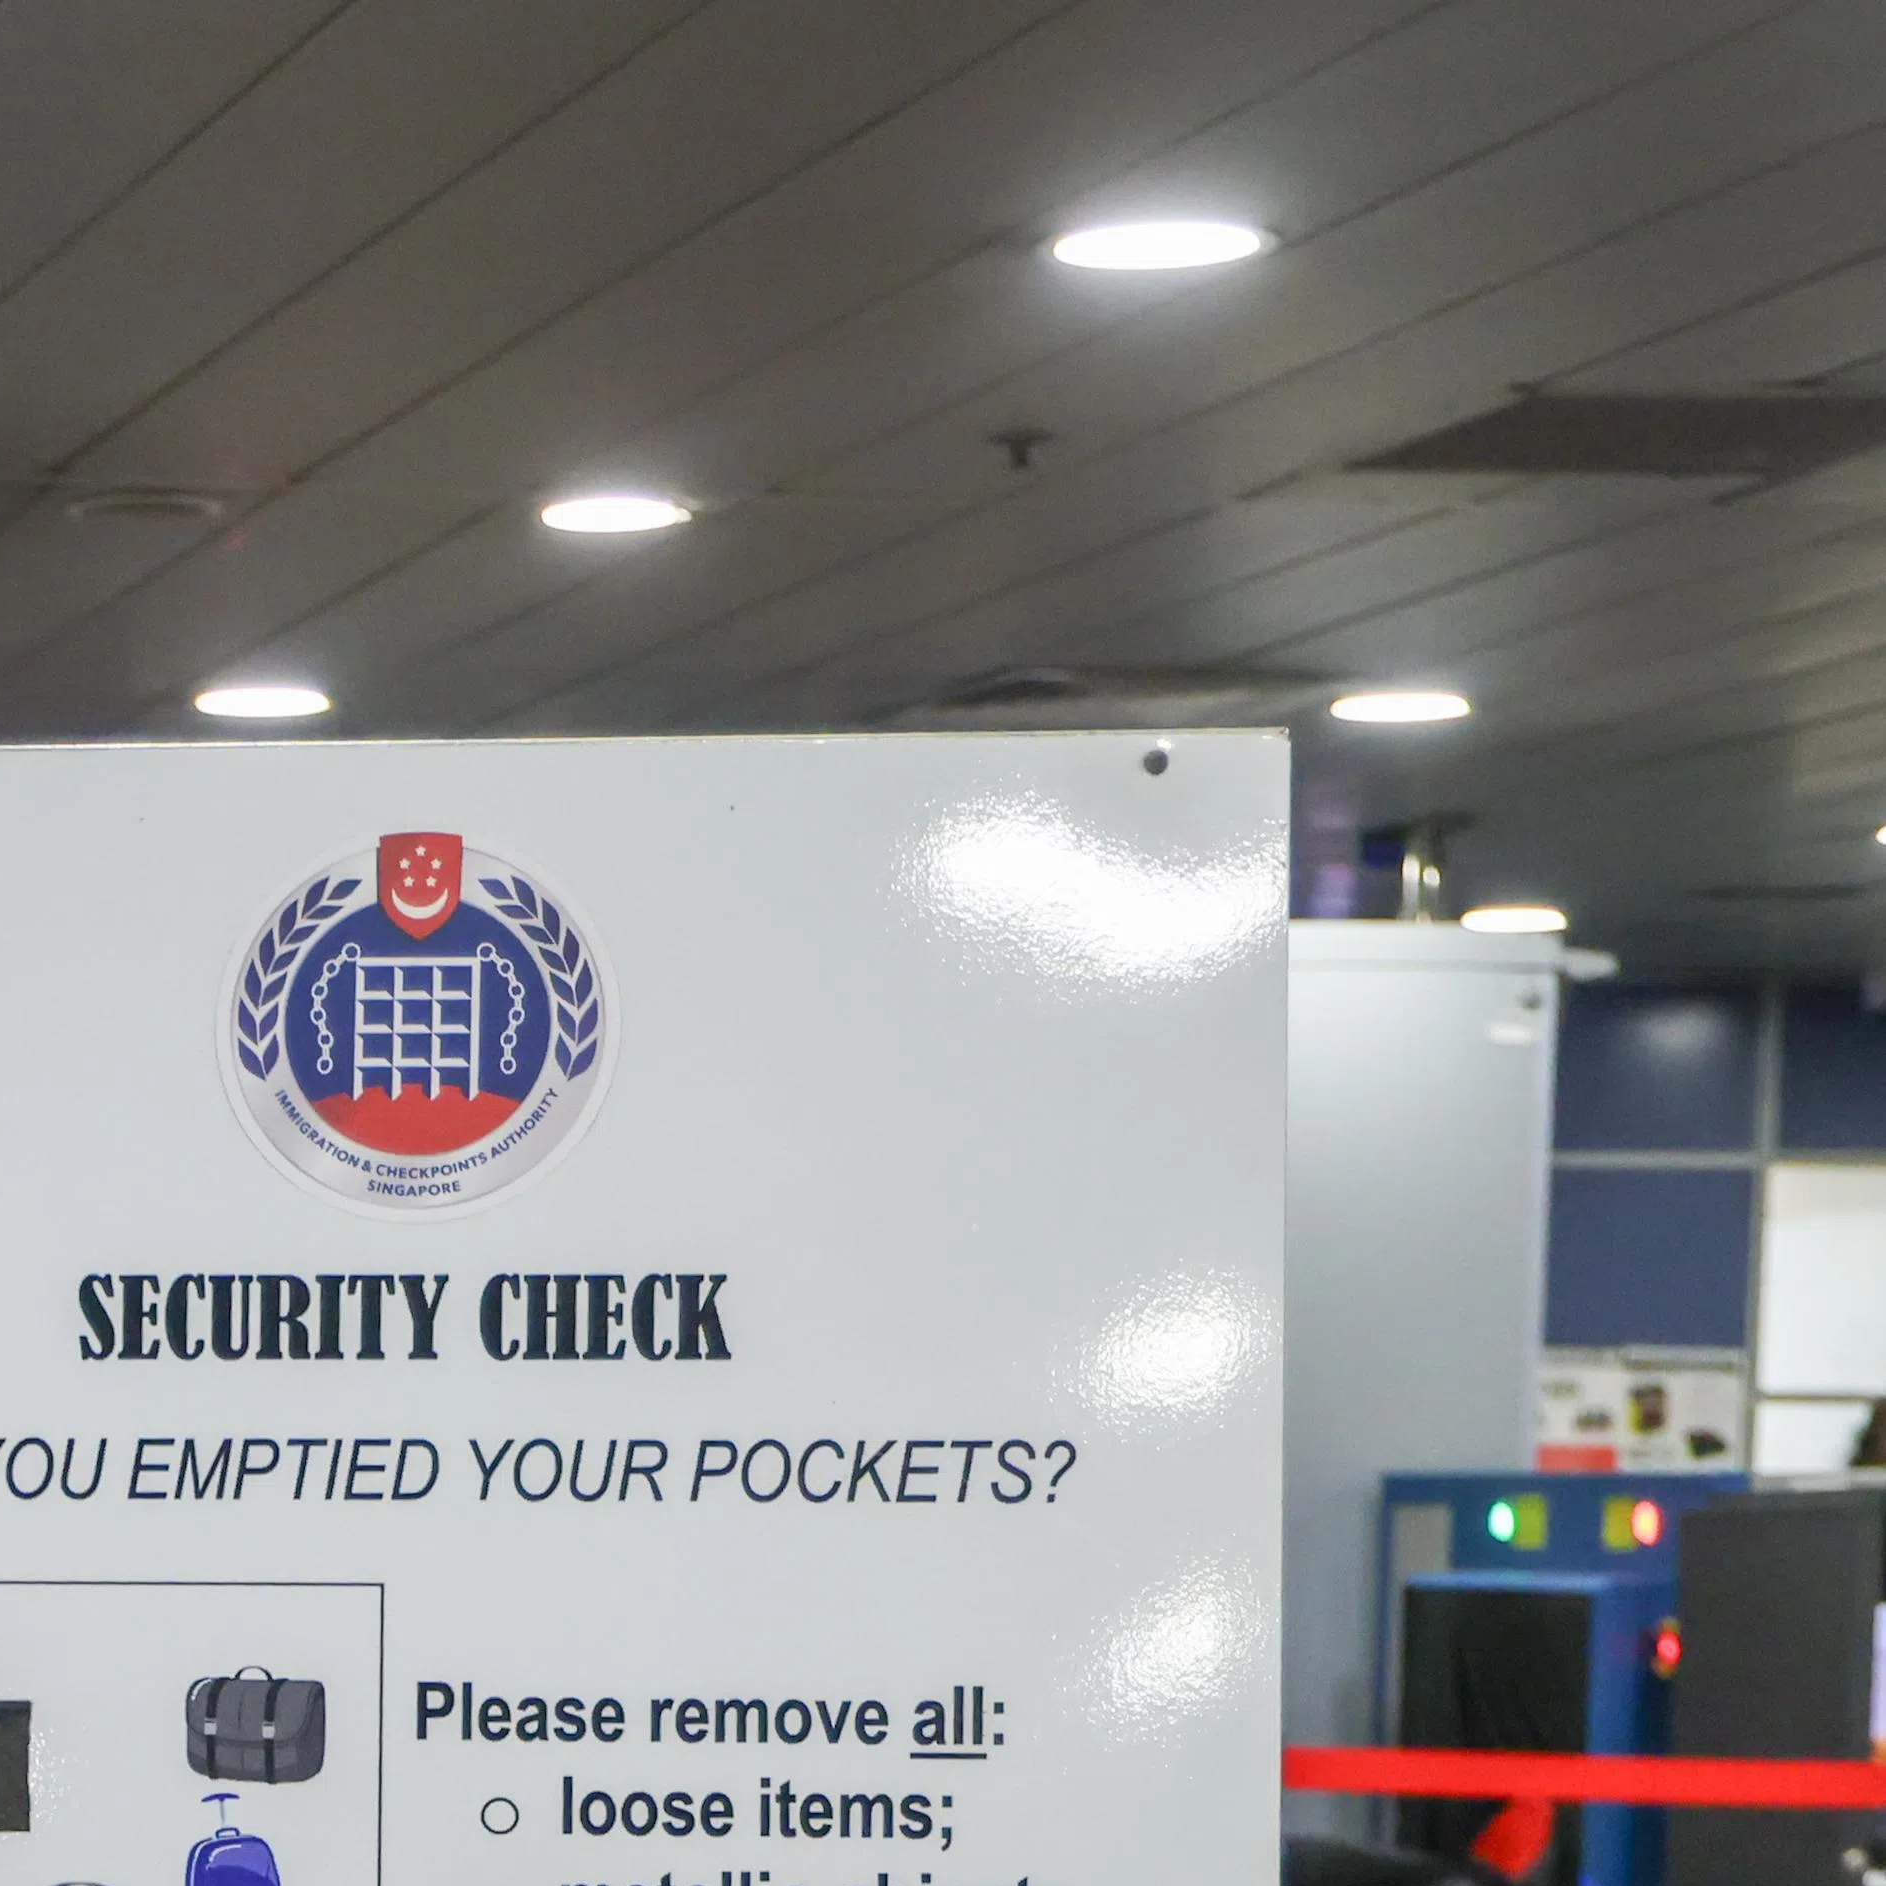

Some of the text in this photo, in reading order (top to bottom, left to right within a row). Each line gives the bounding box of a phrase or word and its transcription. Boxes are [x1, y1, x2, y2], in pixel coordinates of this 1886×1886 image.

[275, 1087, 559, 1180] IMMIGRATION & CHECKPOINTS AUTHORITY
[367, 1179, 462, 1198] SINGAPORE
[79, 1274, 731, 1361] SECURITY CHECK
[128, 1439, 439, 1500] EMPTIED
[469, 1439, 667, 1501] YOUR
[691, 1439, 1077, 1503] POCKETS?
[417, 1682, 1005, 1746] Please remove all:
[563, 1776, 952, 1851] loose items;
